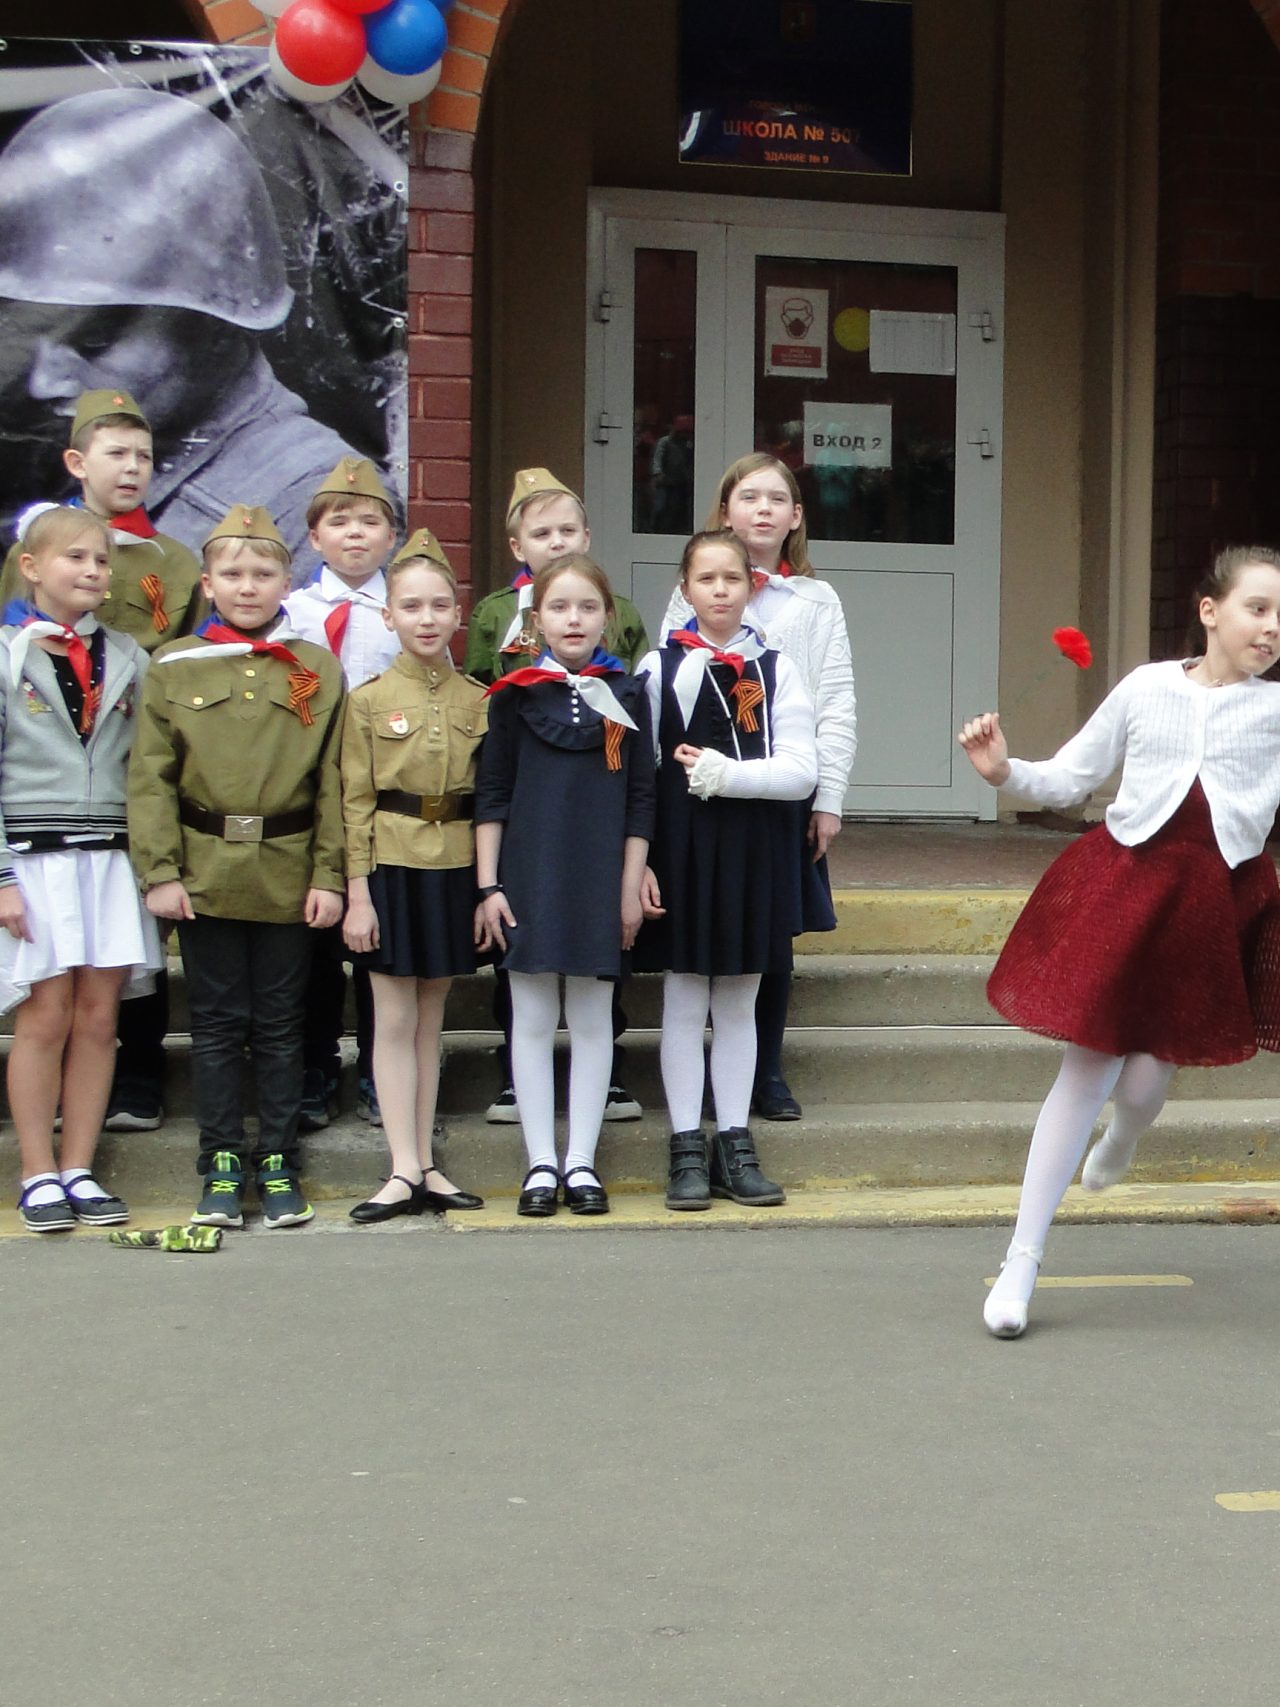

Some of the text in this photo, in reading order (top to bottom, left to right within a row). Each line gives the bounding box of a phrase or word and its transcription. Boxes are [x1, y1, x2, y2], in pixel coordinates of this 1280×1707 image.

[722, 119, 798, 140] ШКОЛА
[803, 125, 825, 142] №
[763, 150, 807, 164] ЗДАНИЕ
[812, 434, 882, 452] ВХОД 2
